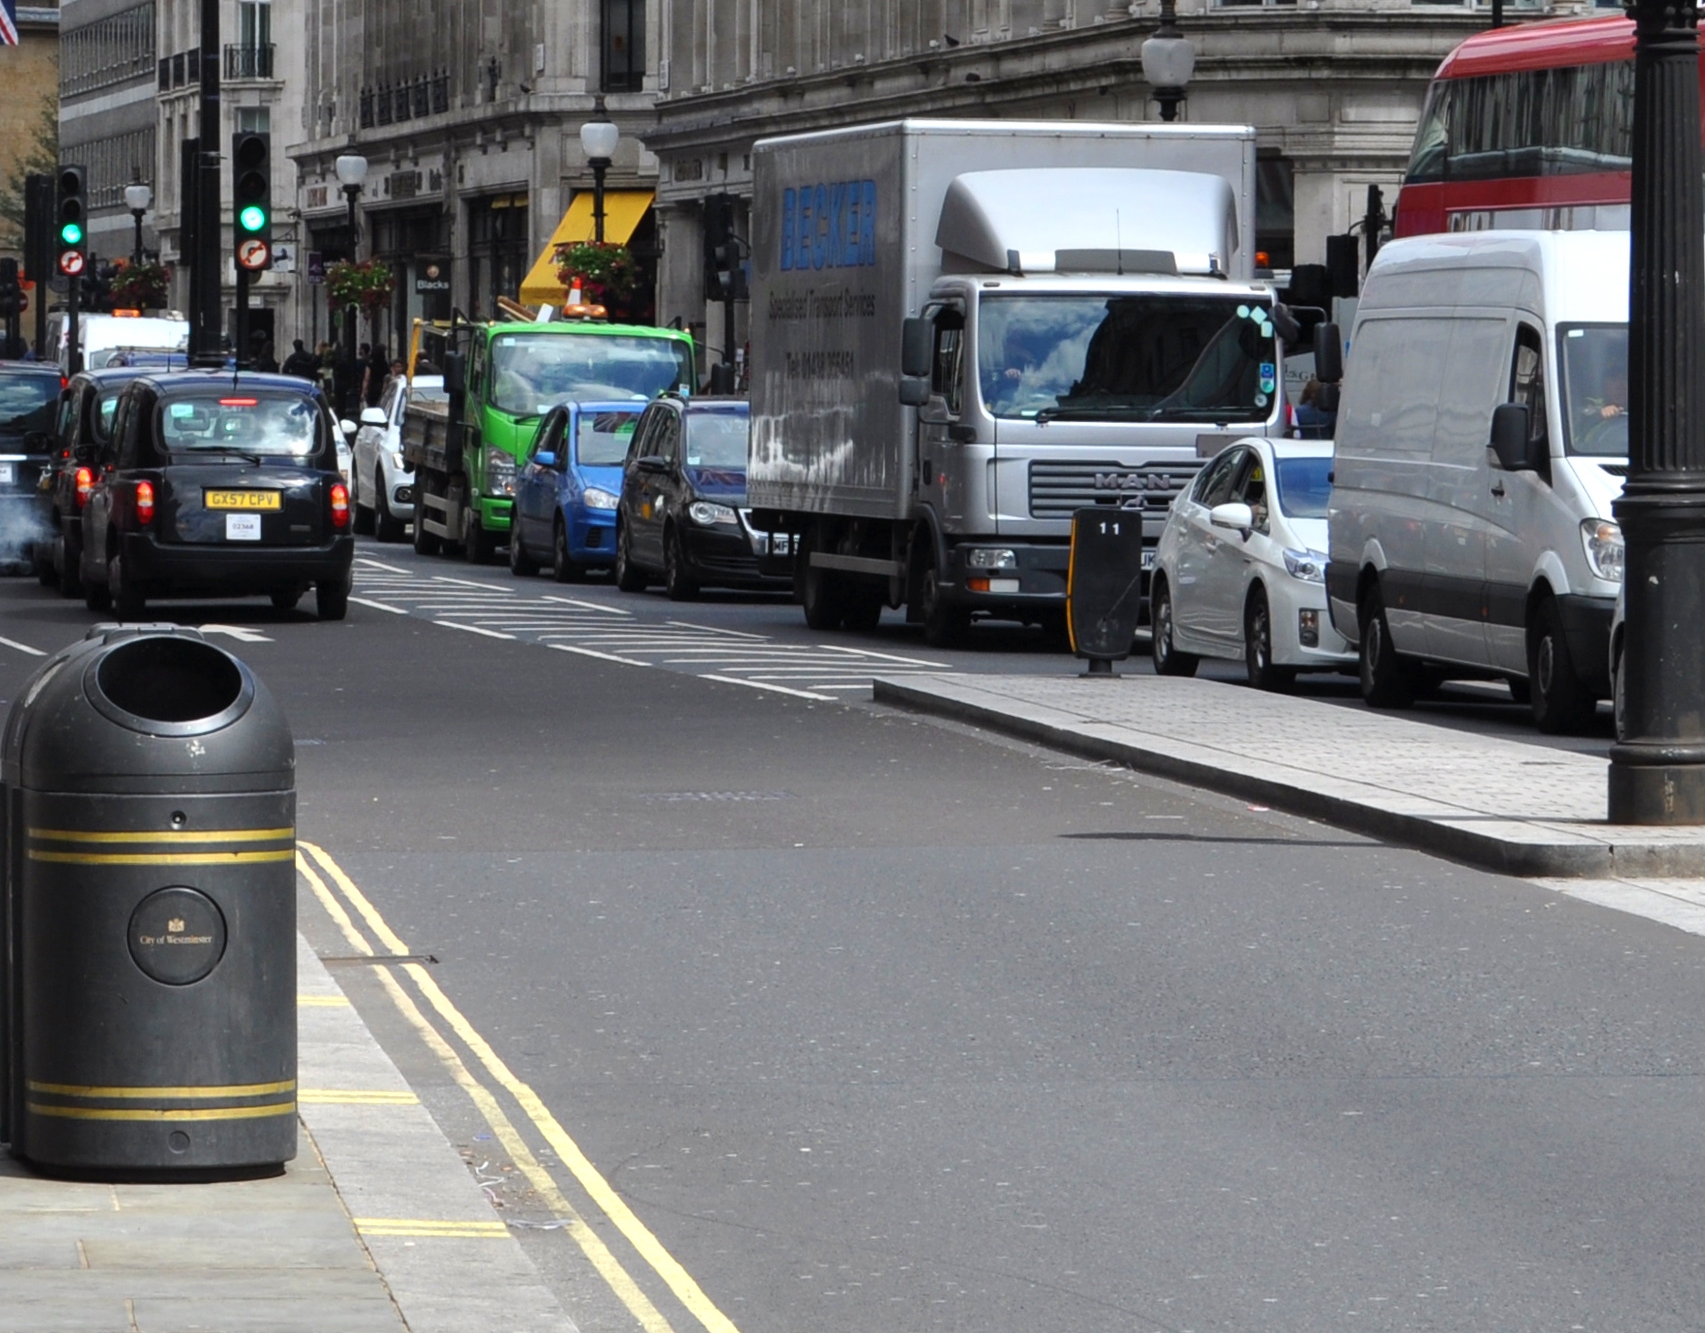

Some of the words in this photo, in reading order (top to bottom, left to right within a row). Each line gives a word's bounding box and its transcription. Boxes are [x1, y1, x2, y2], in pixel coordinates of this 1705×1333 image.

[780, 180, 875, 271] BECKER
[416, 279, 450, 290] Blacks
[844, 286, 876, 318] Services
[1095, 473, 1170, 490] MAN
[211, 492, 246, 506] GX57
[248, 493, 274, 506] CPV
[140, 935, 155, 947] City
[156, 935, 165, 945] of
[166, 934, 212, 945] Westminster
